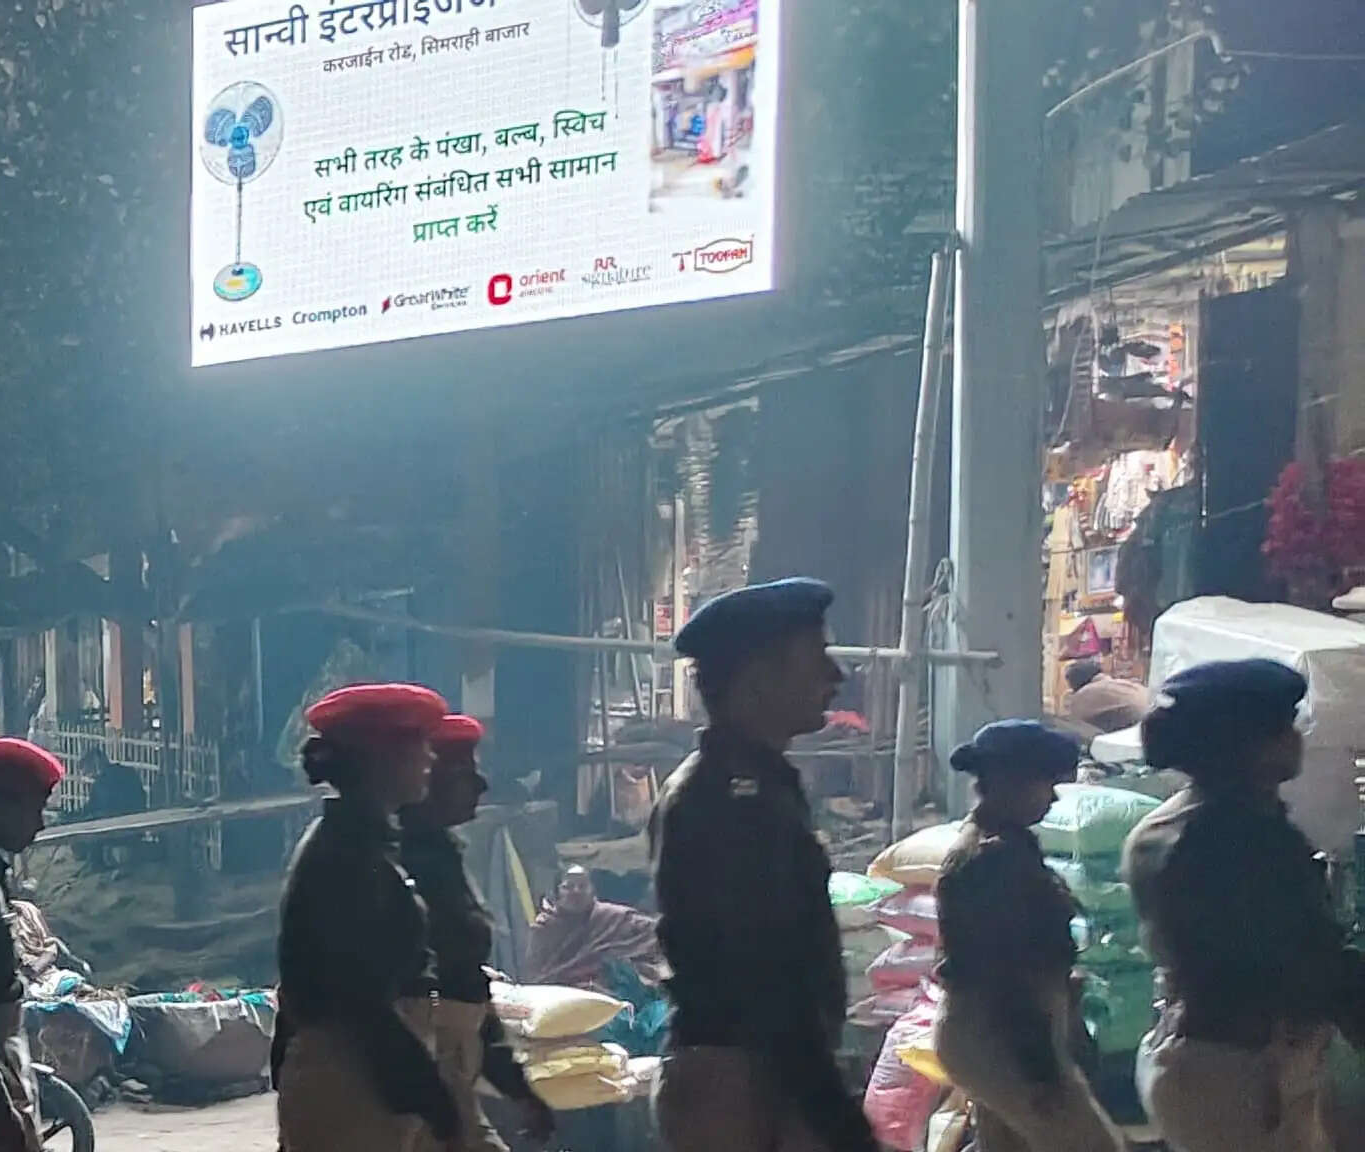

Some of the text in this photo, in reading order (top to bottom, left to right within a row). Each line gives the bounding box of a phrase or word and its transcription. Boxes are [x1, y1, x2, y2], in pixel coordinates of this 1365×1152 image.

[421, 28, 479, 56] सिमराही
[485, 22, 531, 44] बाजार
[314, 110, 607, 177] सभी तरह के पंखा, बल्ब, स्विच
[303, 151, 619, 223] एवं वायरिंग संबंधित सभी सामान
[413, 203, 499, 243] प्राप्त करें
[519, 269, 565, 286] orient
[220, 316, 282, 336] HAVELLS
[292, 304, 368, 325] Crompton
